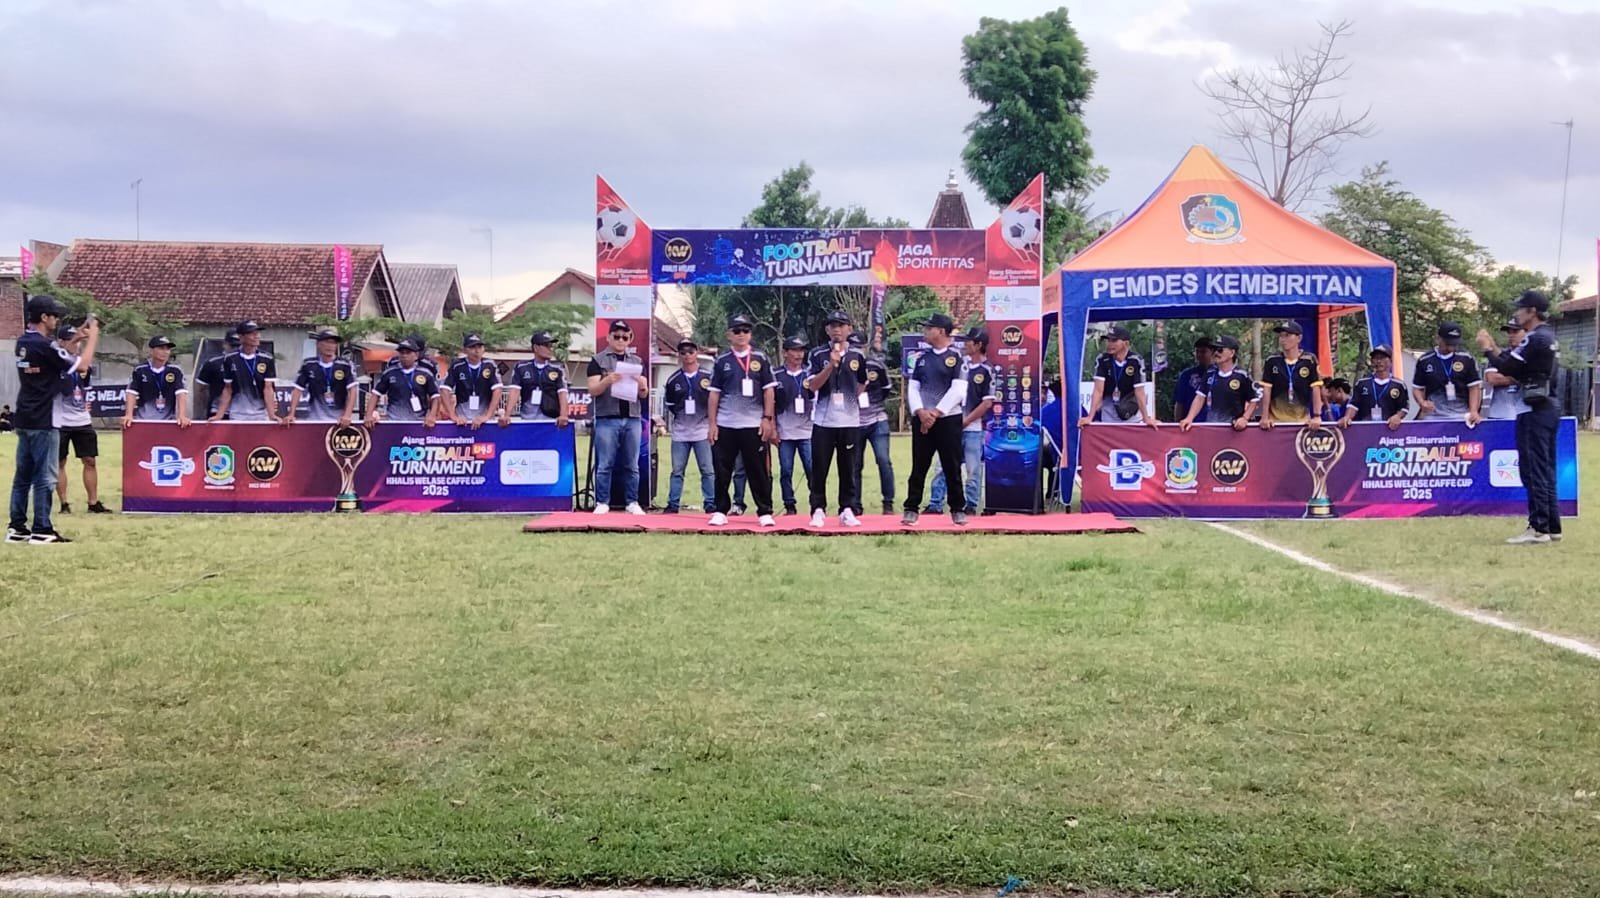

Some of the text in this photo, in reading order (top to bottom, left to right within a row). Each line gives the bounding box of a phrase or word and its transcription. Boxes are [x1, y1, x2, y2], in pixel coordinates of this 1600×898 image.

[763, 236, 861, 262] FOOTBALL
[897, 244, 933, 258] JAGA
[765, 250, 874, 278] TURNAMENT
[896, 257, 975, 269] SPORTIFITAS
[1092, 273, 1362, 299] PEMDES KEMBIRITAN
[97, 389, 127, 401] WELA
[567, 393, 592, 404] ALIS
[568, 405, 588, 415] FFE
[402, 436, 425, 445] Ajang
[1379, 434, 1459, 446] Ajang Silaturrahmi
[390, 443, 494, 461] FOOTBALL U45
[1366, 443, 1480, 463] FOOTBALL U45
[390, 460, 485, 475] TURNAMENT
[1366, 460, 1472, 478] TURNAMENT
[386, 477, 486, 485] KHALIS WELASE CAFFE CUP
[1362, 478, 1473, 489] KHALIS WELASE CAFFE CUP
[422, 485, 449, 496] 2025
[1402, 488, 1433, 500] 2025
